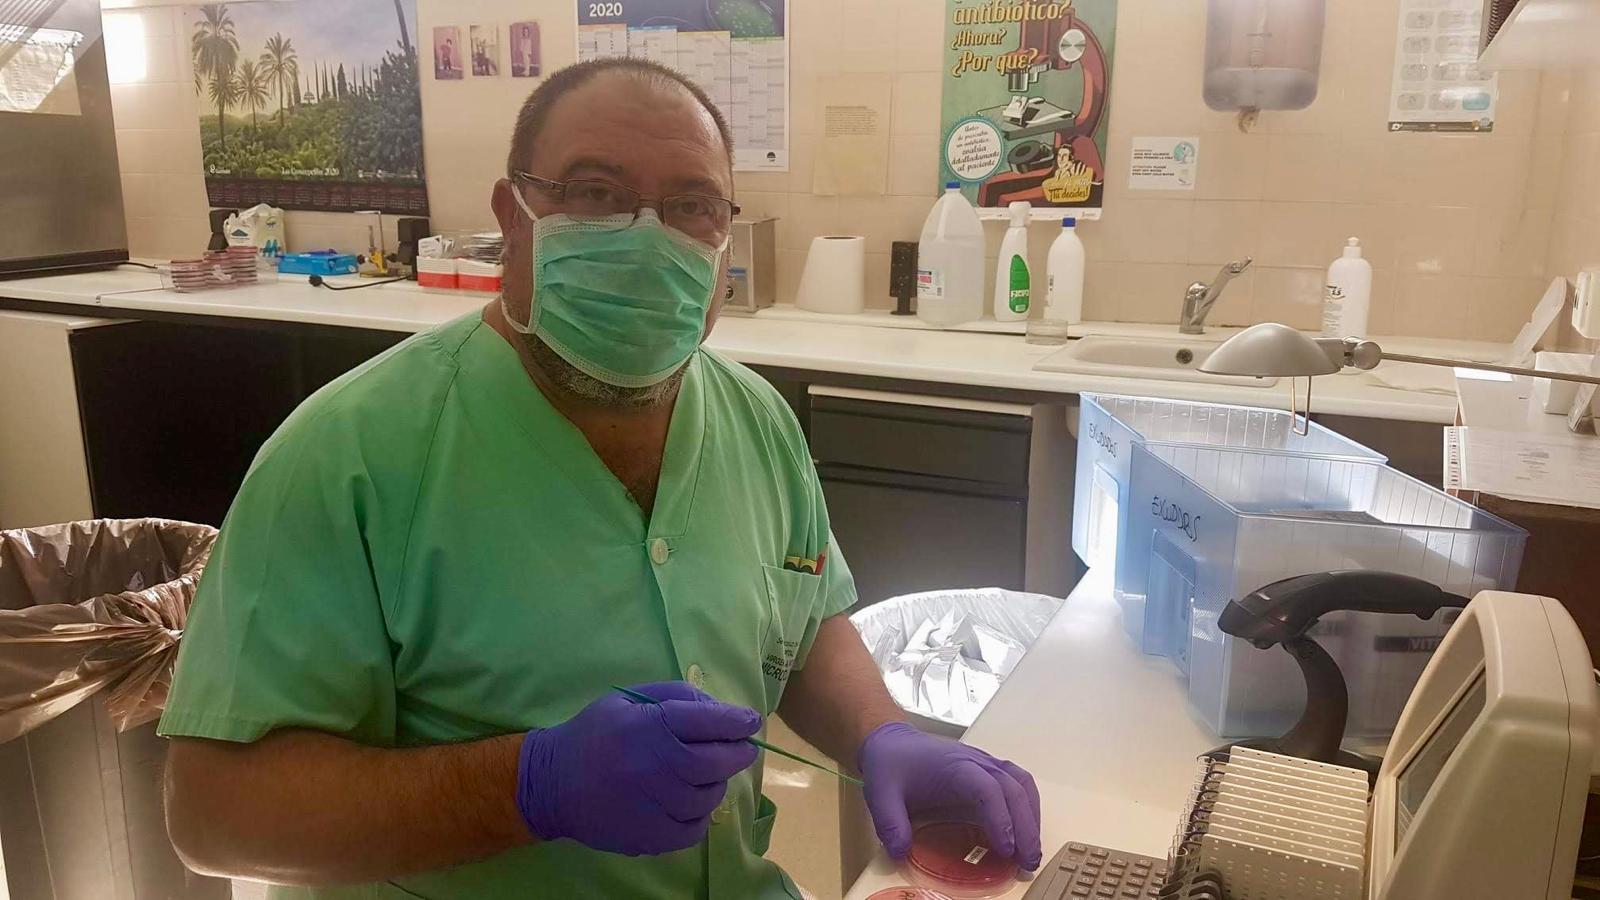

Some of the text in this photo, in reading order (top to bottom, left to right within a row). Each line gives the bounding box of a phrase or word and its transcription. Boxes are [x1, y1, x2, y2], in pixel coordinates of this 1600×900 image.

[589, 2, 623, 17] 2020
[952, 0, 1072, 25] antibiótico?
[952, 28, 1007, 50] ¿Ahora?
[952, 47, 1039, 77] ¿Por qué?
